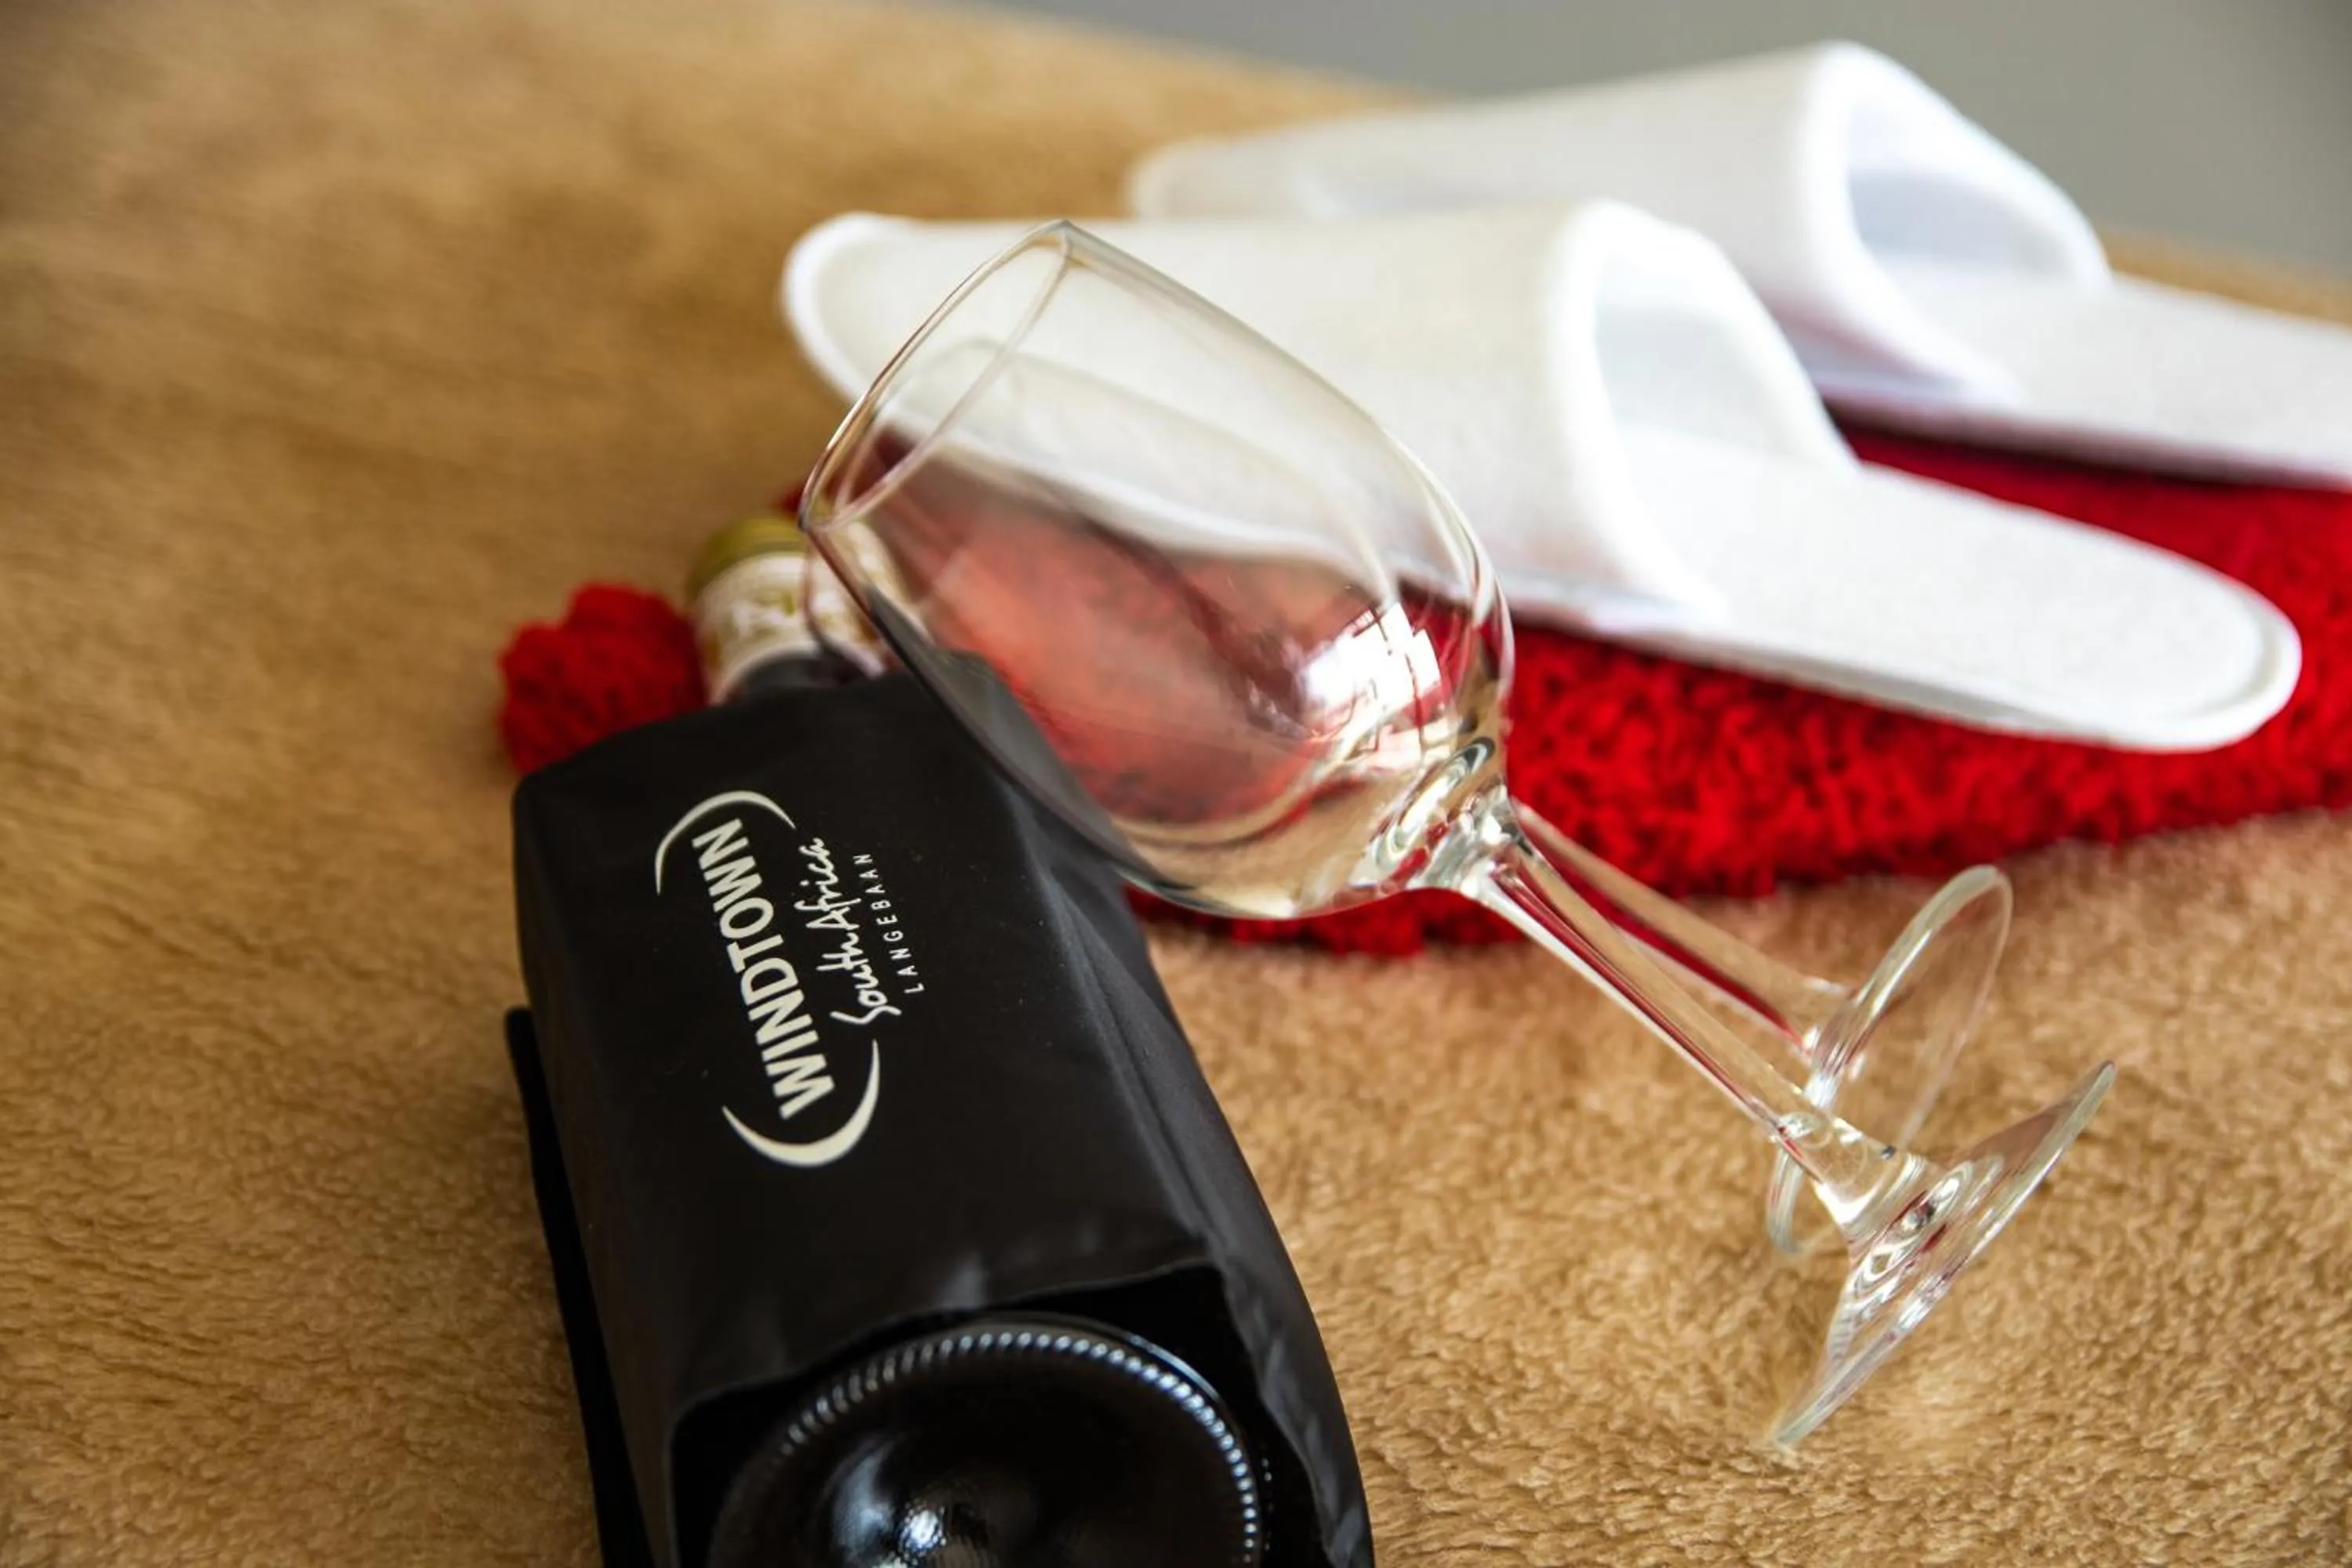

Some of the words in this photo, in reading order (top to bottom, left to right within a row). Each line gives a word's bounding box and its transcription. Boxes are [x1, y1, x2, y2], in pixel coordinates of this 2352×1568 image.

[793, 837, 862, 932] Africa
[852, 853, 925, 995] LANGEBAAN
[691, 818, 836, 1120] WINDTOWN
[815, 931, 903, 1025] South
